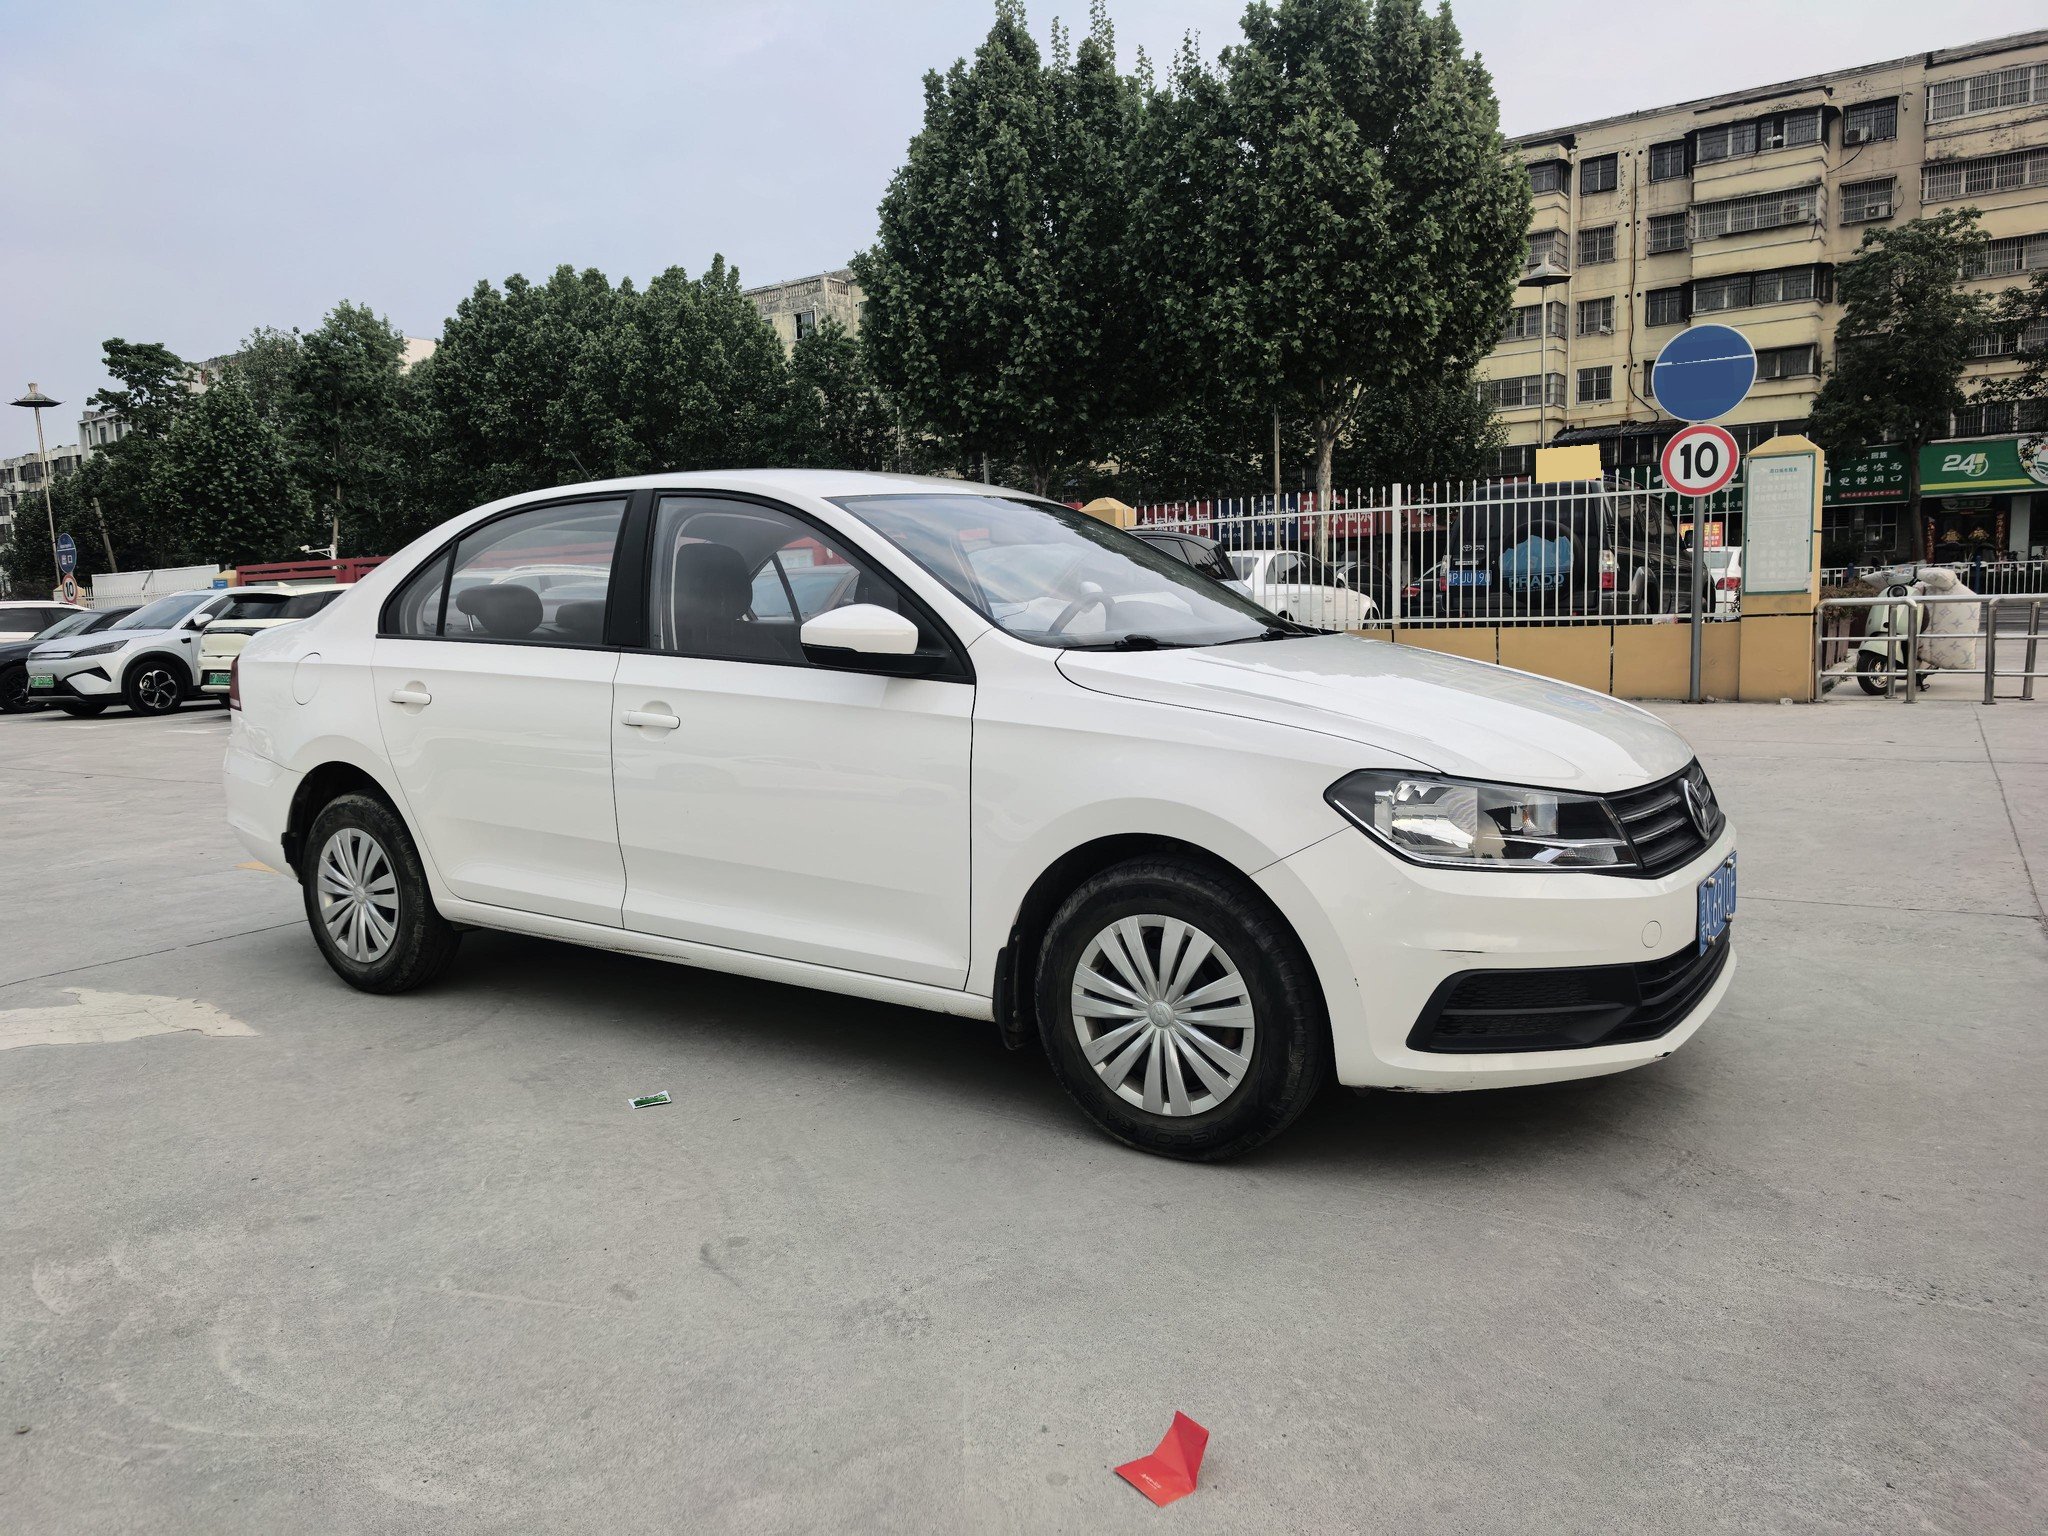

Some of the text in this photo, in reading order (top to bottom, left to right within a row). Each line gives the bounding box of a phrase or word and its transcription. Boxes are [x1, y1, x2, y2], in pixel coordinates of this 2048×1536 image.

[1680, 441, 1719, 479] 10
[1508, 573, 1565, 588] PRADO
[66, 581, 74, 598] 10
